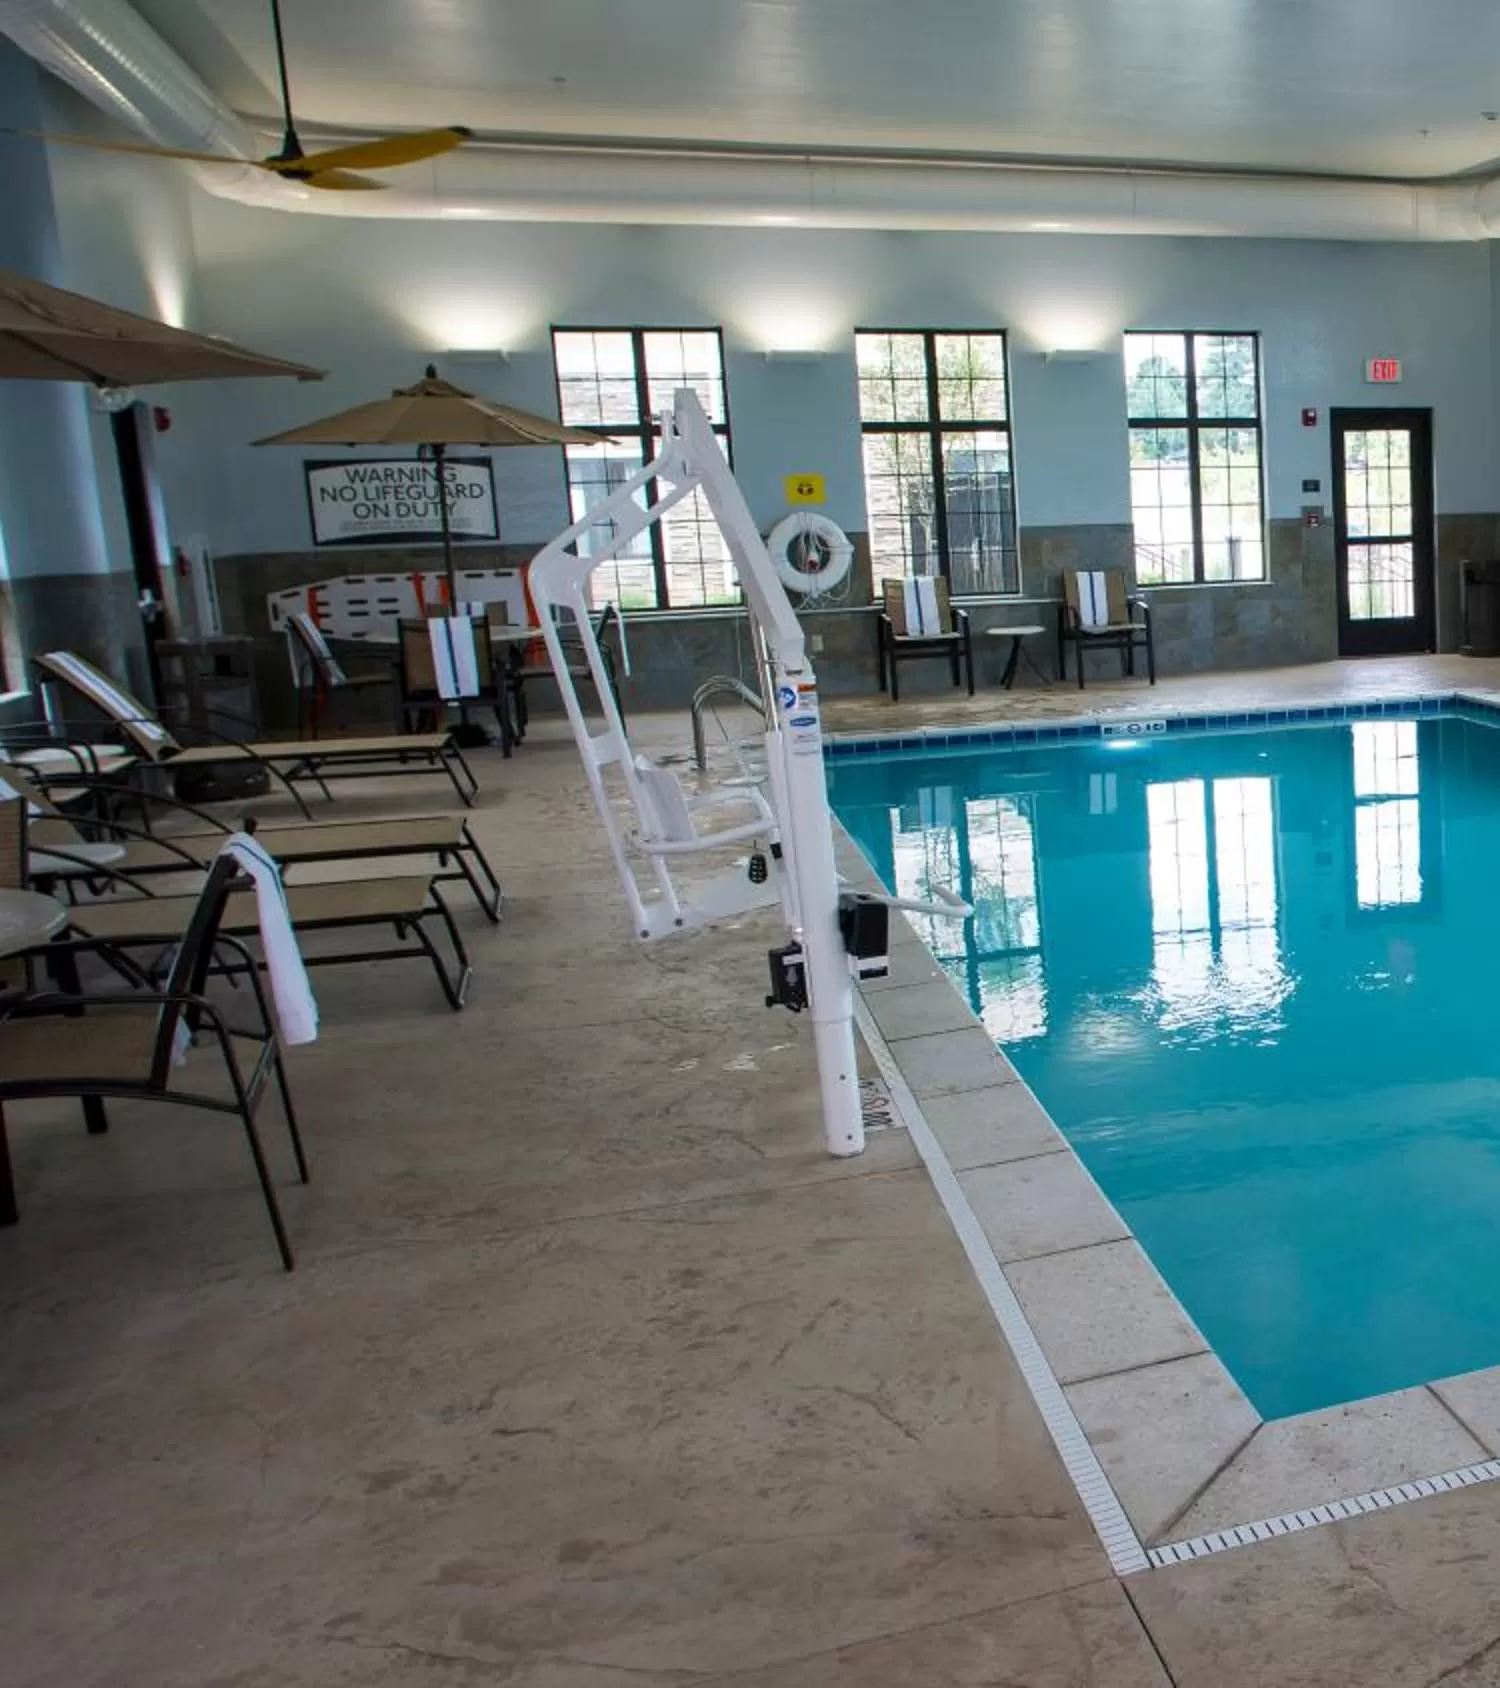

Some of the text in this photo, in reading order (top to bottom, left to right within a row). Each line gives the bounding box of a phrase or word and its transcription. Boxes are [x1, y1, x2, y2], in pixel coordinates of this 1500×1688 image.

[1372, 360, 1399, 381] EXIT
[344, 466, 457, 483] WARNING
[319, 486, 357, 503] NO
[352, 502, 457, 518] ON DUTY
